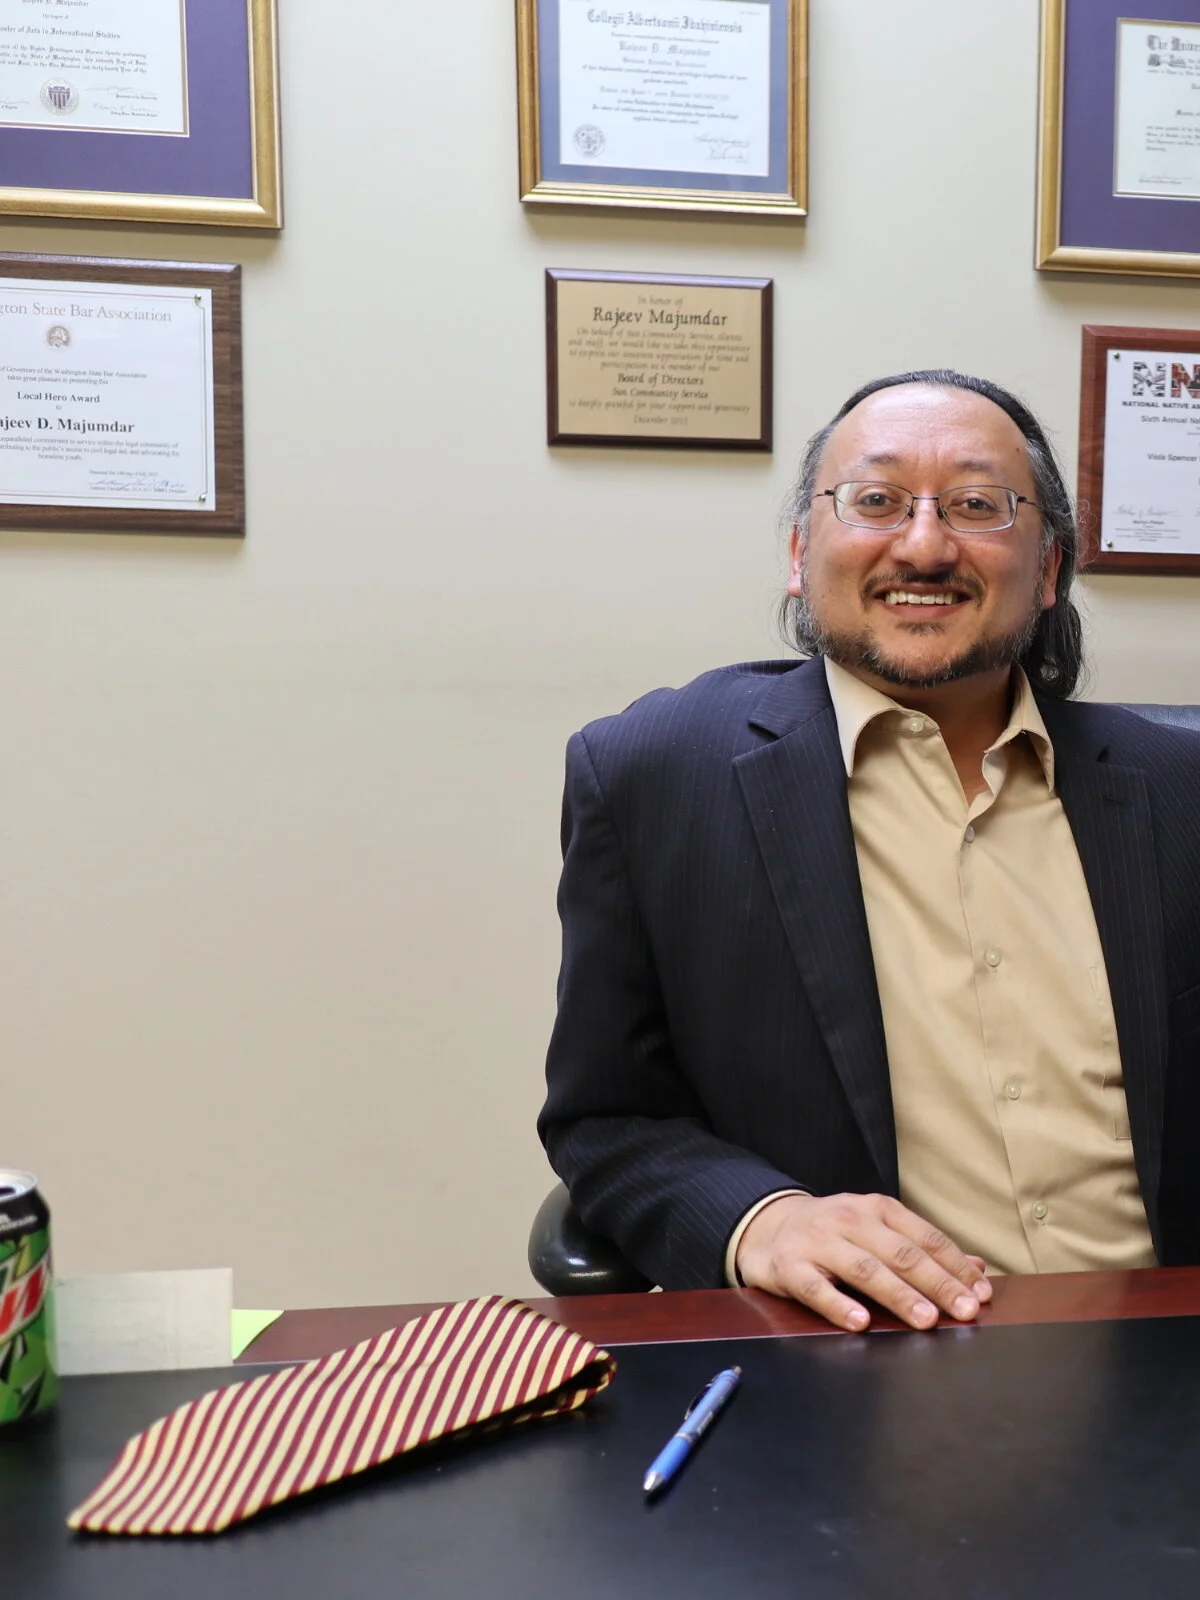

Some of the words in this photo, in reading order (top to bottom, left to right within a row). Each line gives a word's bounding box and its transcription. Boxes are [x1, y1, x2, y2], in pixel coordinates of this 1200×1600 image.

[32, 302, 67, 316] State
[70, 303, 96, 318] Bar
[97, 305, 172, 322] Association
[592, 306, 643, 330] Rajeev
[648, 308, 728, 331] Majumdar
[617, 372, 645, 384] Board
[648, 372, 659, 388] of
[662, 374, 704, 386] Directors
[17, 391, 42, 401] Local
[45, 392, 67, 402] Hero
[69, 394, 101, 404] Award
[630, 387, 679, 401] Community
[1122, 400, 1160, 408] NATIONAL
[1162, 402, 1189, 410] NATIVE
[37, 416, 54, 431] D.
[57, 417, 136, 435] Majumdar
